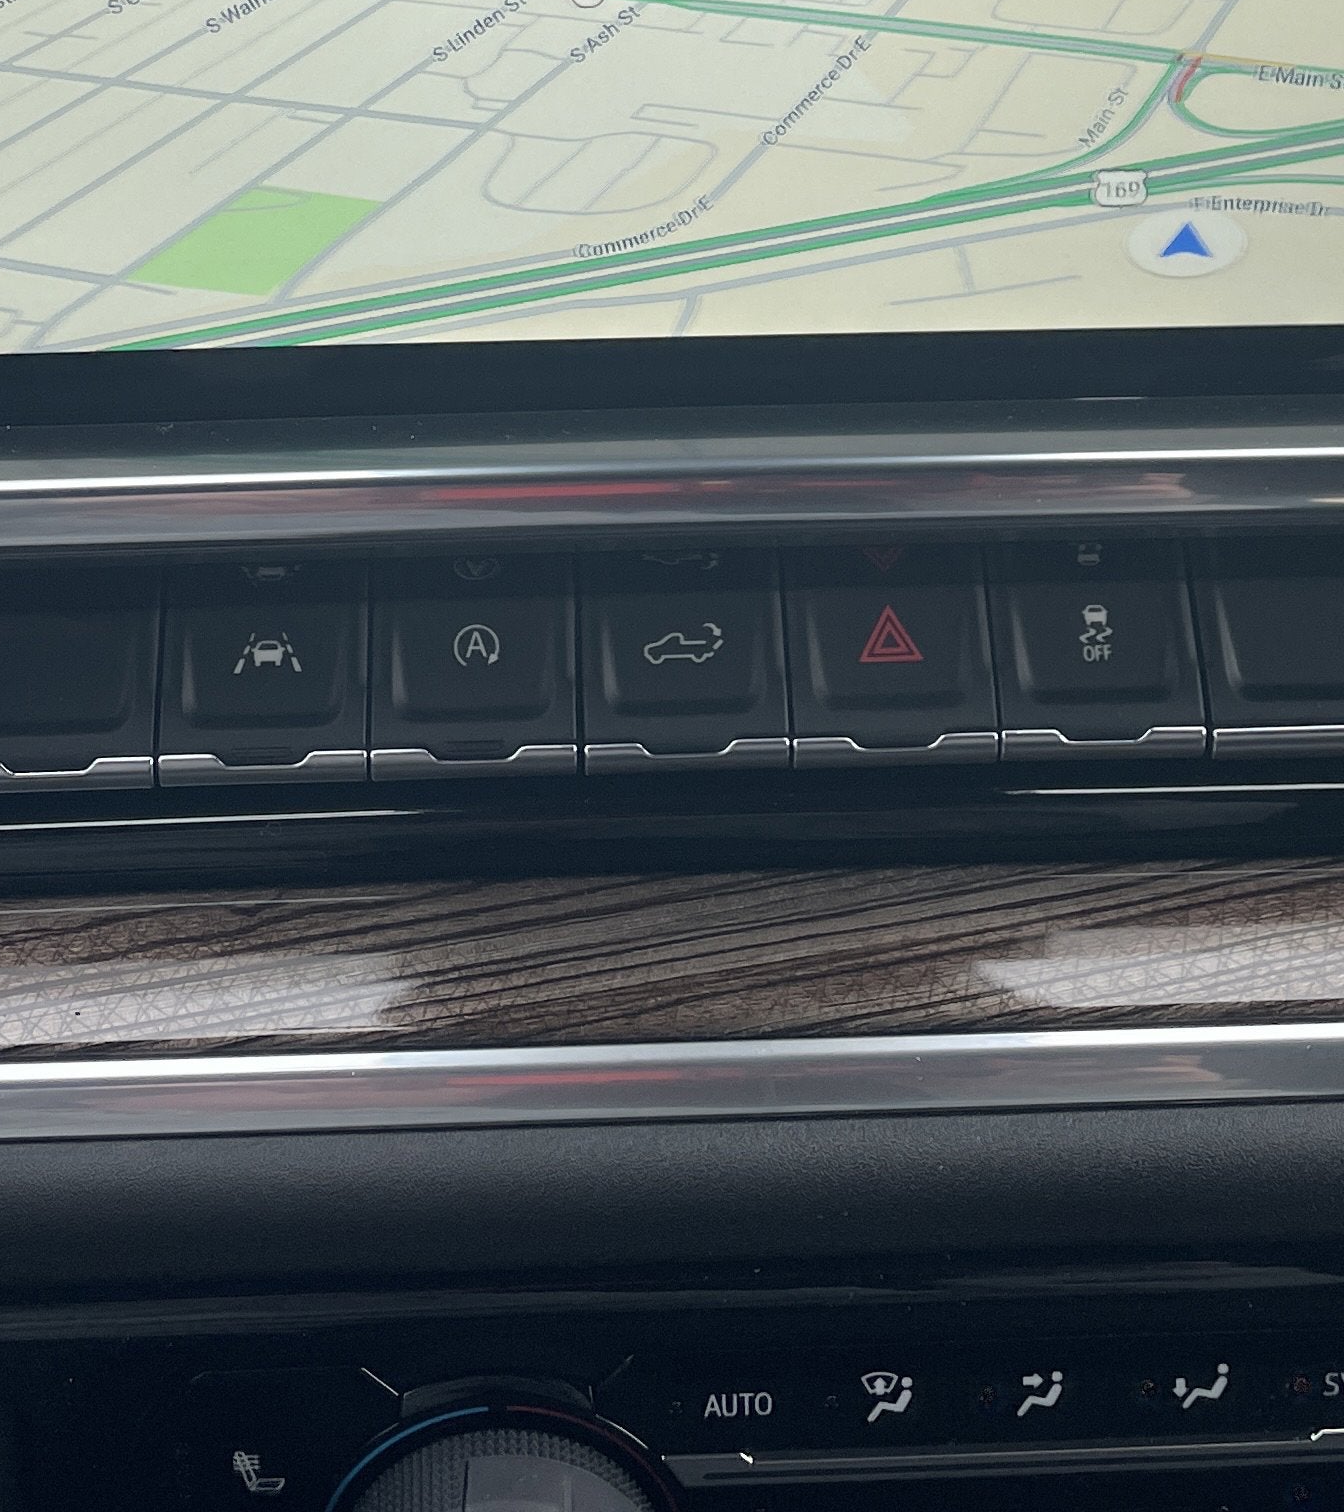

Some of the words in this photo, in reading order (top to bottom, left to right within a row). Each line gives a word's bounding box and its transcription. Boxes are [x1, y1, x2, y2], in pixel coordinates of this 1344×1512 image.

[206, 16, 221, 34] S
[432, 46, 449, 63] S
[447, 7, 507, 53] Linden
[570, 46, 587, 64] S
[586, 21, 621, 55] Ash
[618, 5, 641, 27] St
[1258, 64, 1271, 82] E
[1274, 65, 1324, 89] Main
[762, 68, 841, 146] Commerce
[836, 52, 858, 71] Dr
[1078, 108, 1116, 149] Main
[1108, 87, 1129, 109] St
[1104, 181, 1141, 199] 169
[577, 218, 678, 259] Commerce
[1082, 643, 1113, 663] OFF
[704, 1391, 773, 1418] AUTO
